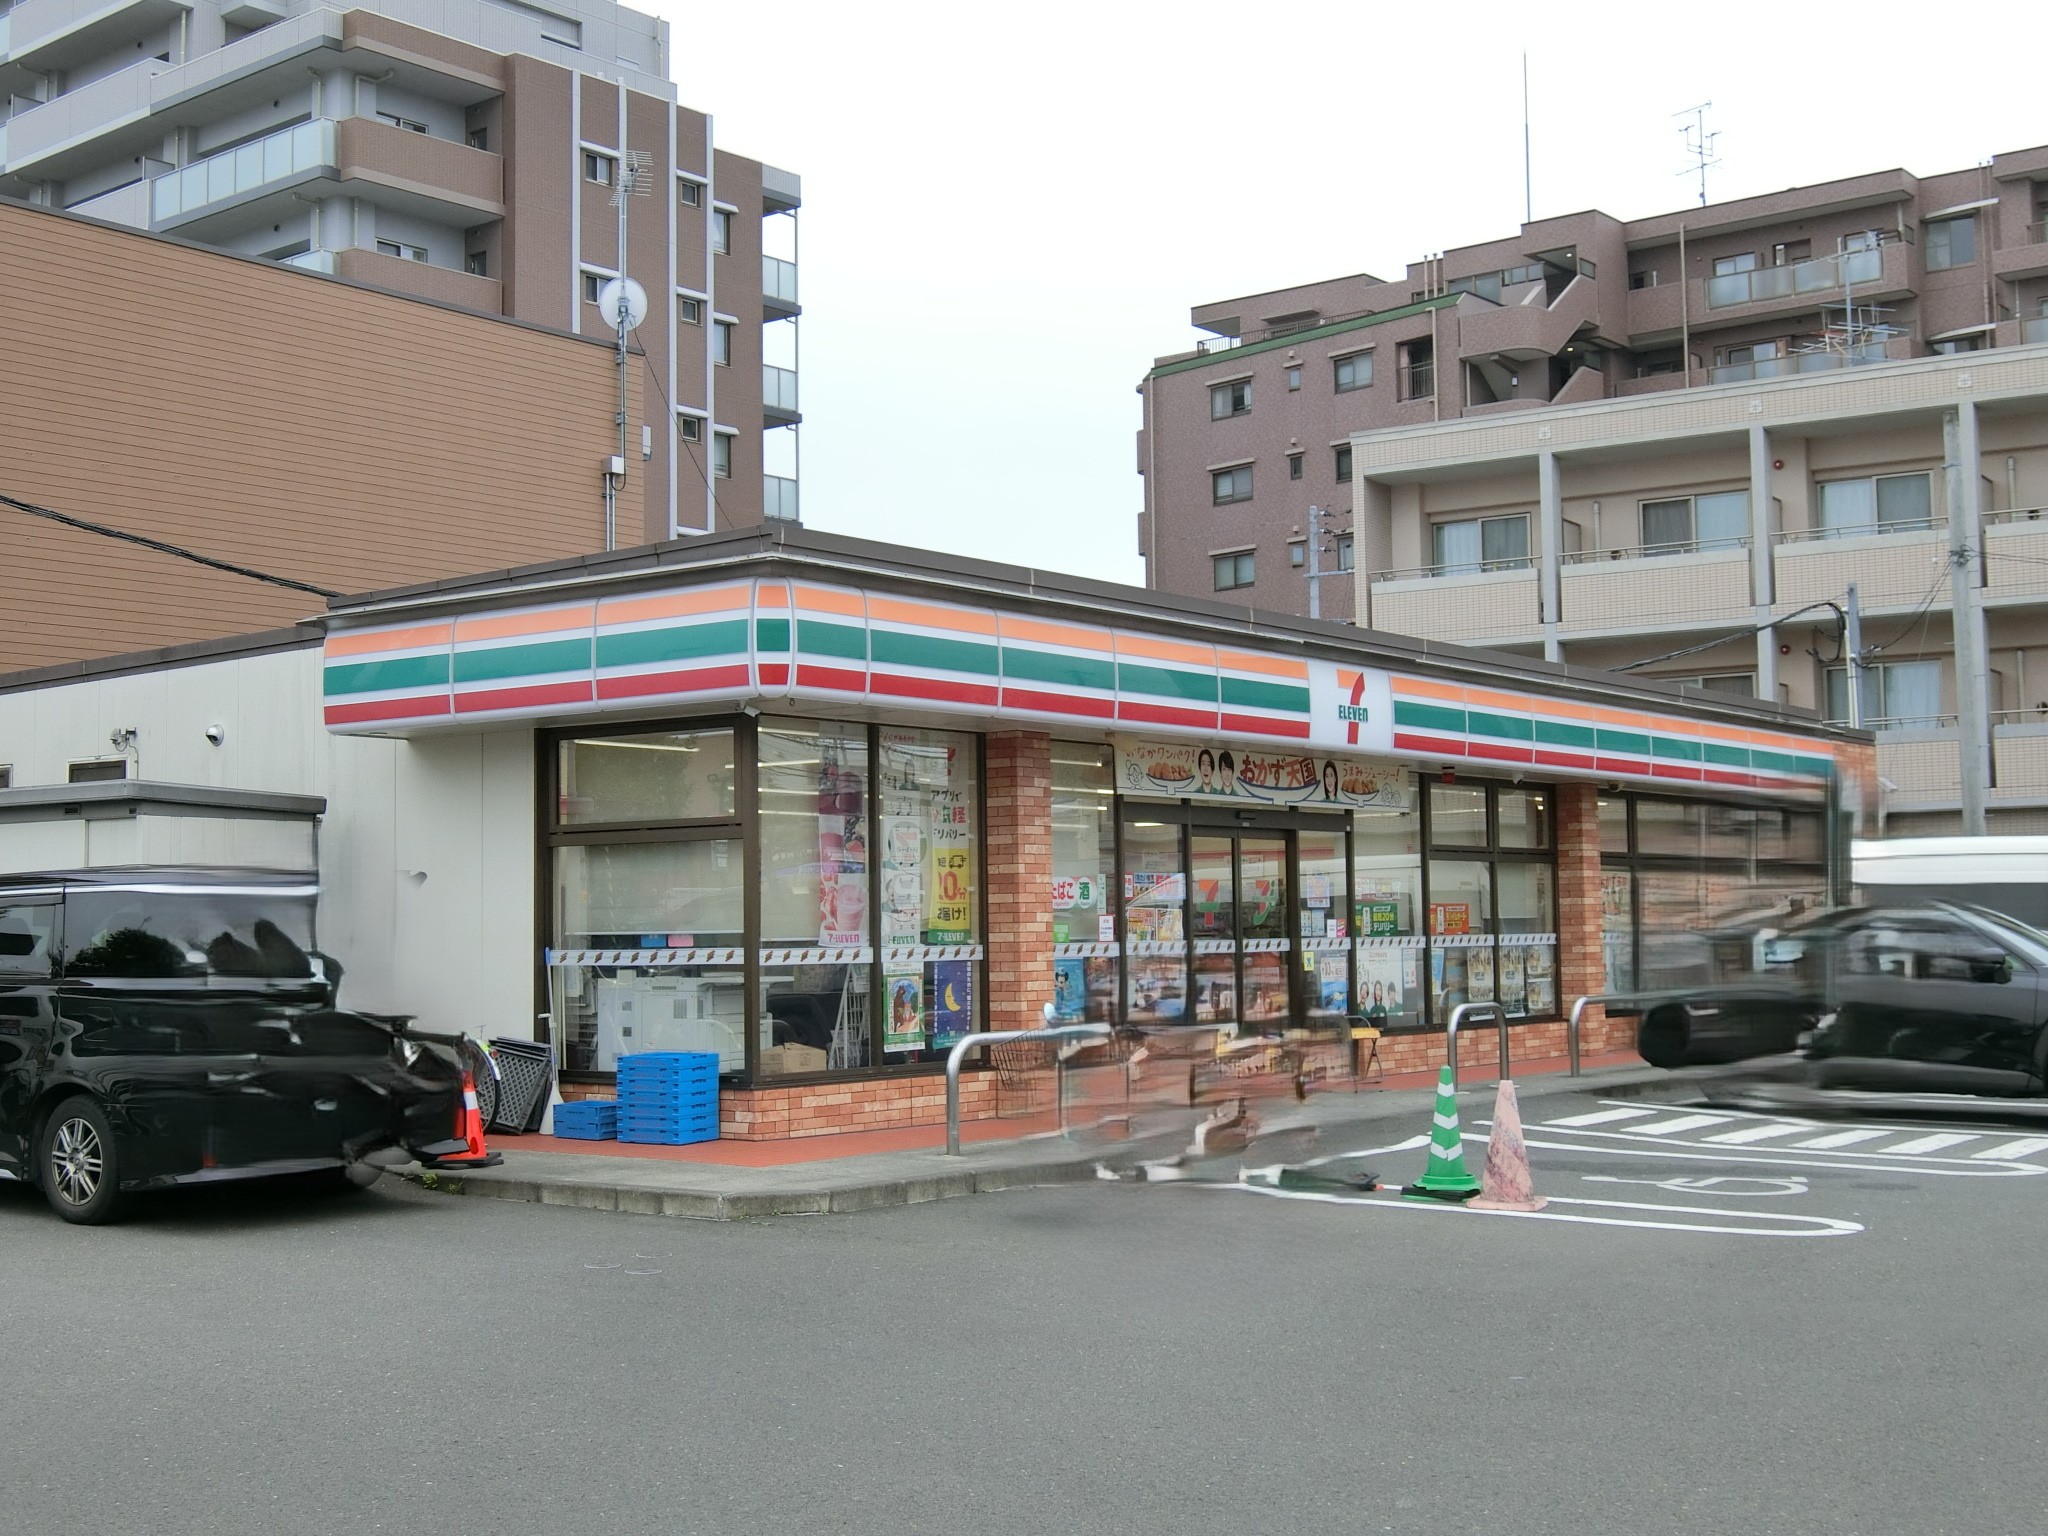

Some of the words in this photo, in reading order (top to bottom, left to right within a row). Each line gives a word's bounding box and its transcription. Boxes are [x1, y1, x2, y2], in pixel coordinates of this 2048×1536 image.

[1240, 754, 1317, 787] おかず天国
[1079, 882, 1090, 900] 酒
